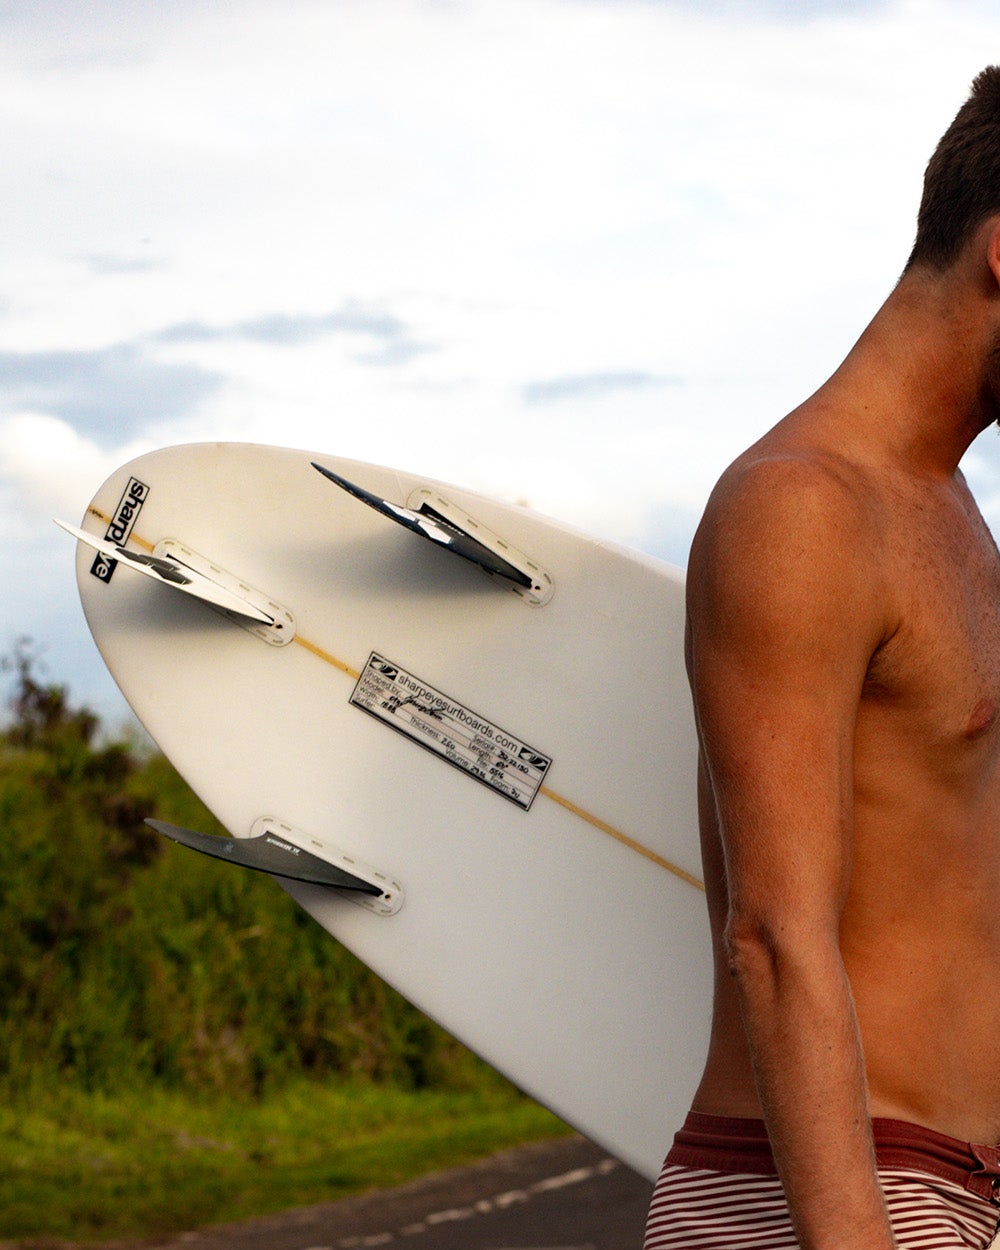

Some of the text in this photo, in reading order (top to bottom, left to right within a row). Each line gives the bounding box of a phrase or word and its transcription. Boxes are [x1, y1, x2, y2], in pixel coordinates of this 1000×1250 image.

[108, 482, 144, 543] sharp
[360, 686, 378, 700] Width:
[364, 669, 391, 689] Shaped
[363, 678, 384, 693] Model:
[469, 742, 493, 760] Length:
[398, 675, 518, 753] sharpeyesurfboards.com
[490, 774, 509, 793] Foam:
